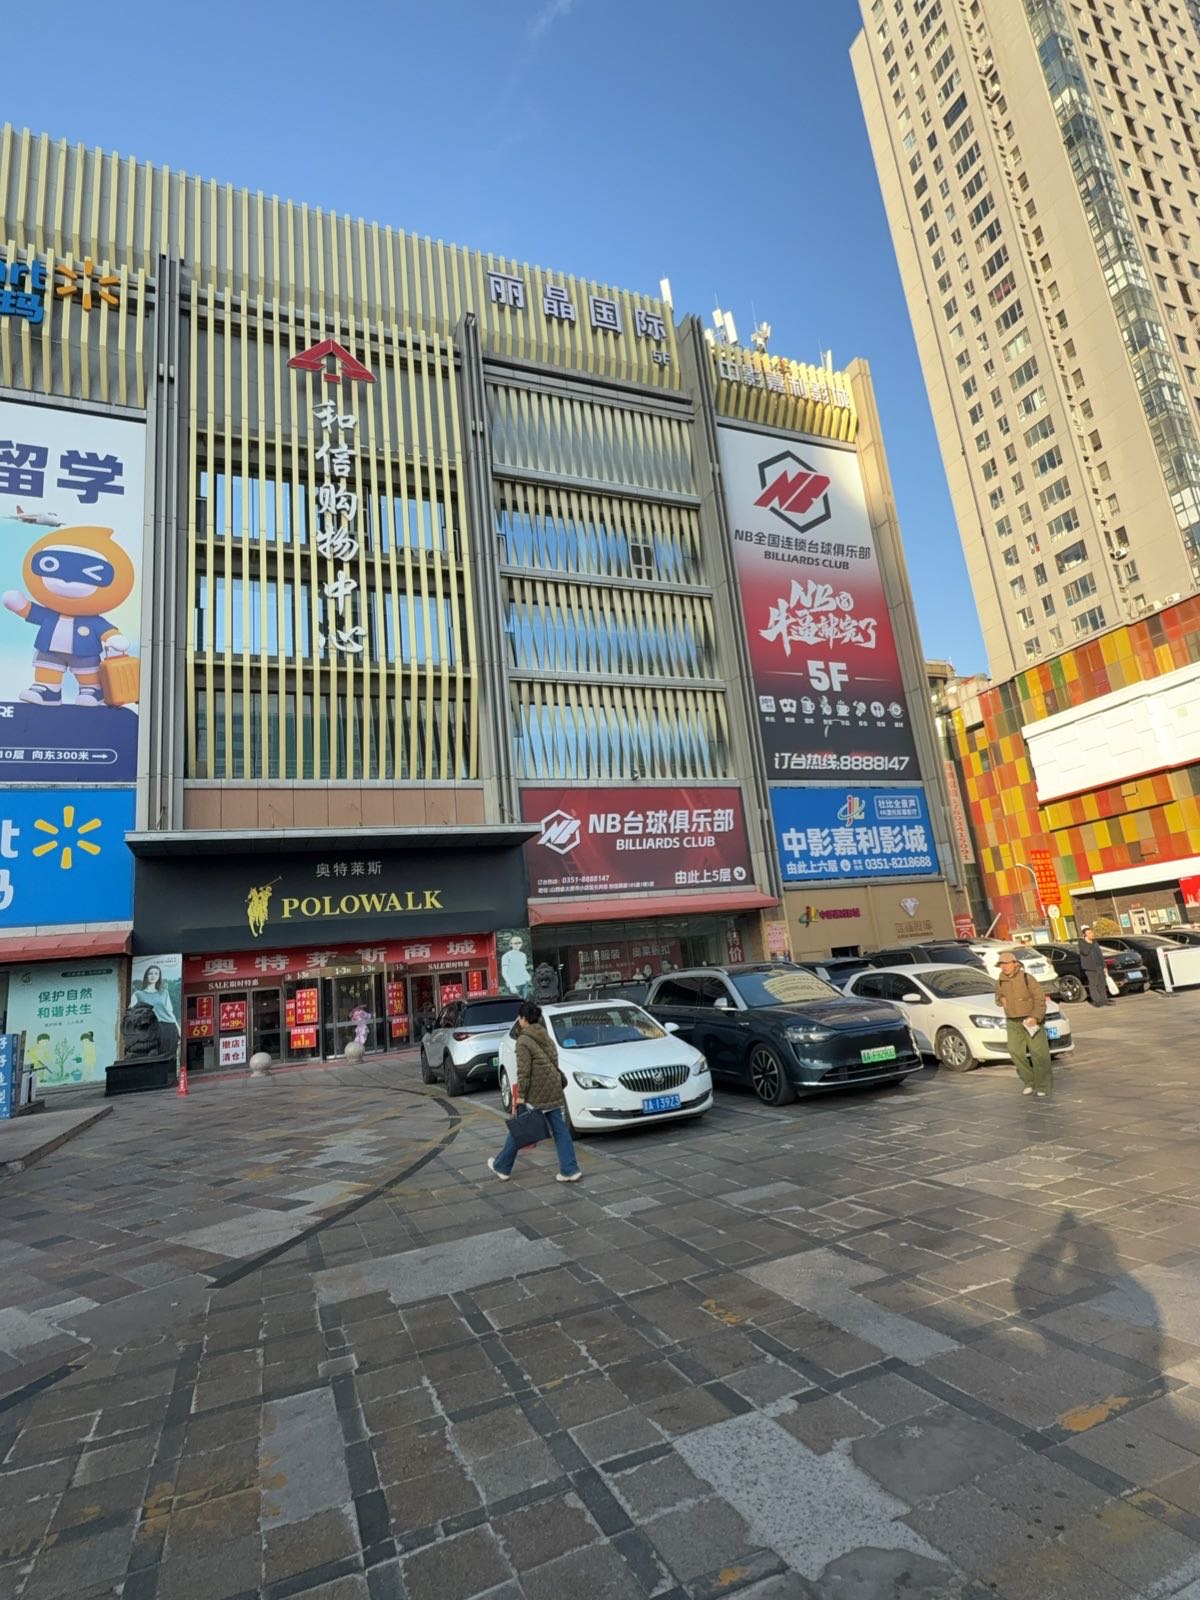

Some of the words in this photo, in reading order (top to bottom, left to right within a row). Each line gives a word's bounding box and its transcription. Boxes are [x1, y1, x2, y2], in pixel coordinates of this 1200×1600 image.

[487, 269, 667, 341] 丽晶国际
[653, 350, 671, 365] 5F
[718, 359, 850, 410] 中影嘉利影城
[0, 439, 125, 505] 留学
[312, 399, 367, 653] 和信购物中心
[734, 528, 872, 561] NB全国连锁台球俱乐部
[764, 550, 820, 567] BILLIARDS
[822, 558, 850, 570] CLUB
[806, 659, 850, 692] 5F
[32, 750, 90, 761] 向东300米
[774, 752, 910, 772] 订台热线:8888147
[588, 808, 734, 835] NB台球俱乐部
[616, 838, 681, 851] BILLIARDS
[683, 836, 716, 848] CLUB
[781, 825, 928, 859] 中影嘉利影城
[316, 860, 383, 878] 奥特莱斯
[786, 859, 839, 875] 由此上六层
[864, 855, 932, 871] 0351-8218688
[674, 868, 732, 885] 由此上5层
[281, 889, 444, 920] POLOWALK
[202, 939, 477, 977] 奥特莱斯商城
[38, 988, 94, 1003] 保护自然
[37, 1003, 93, 1020] 和谐共生
[192, 1025, 209, 1037] 69
